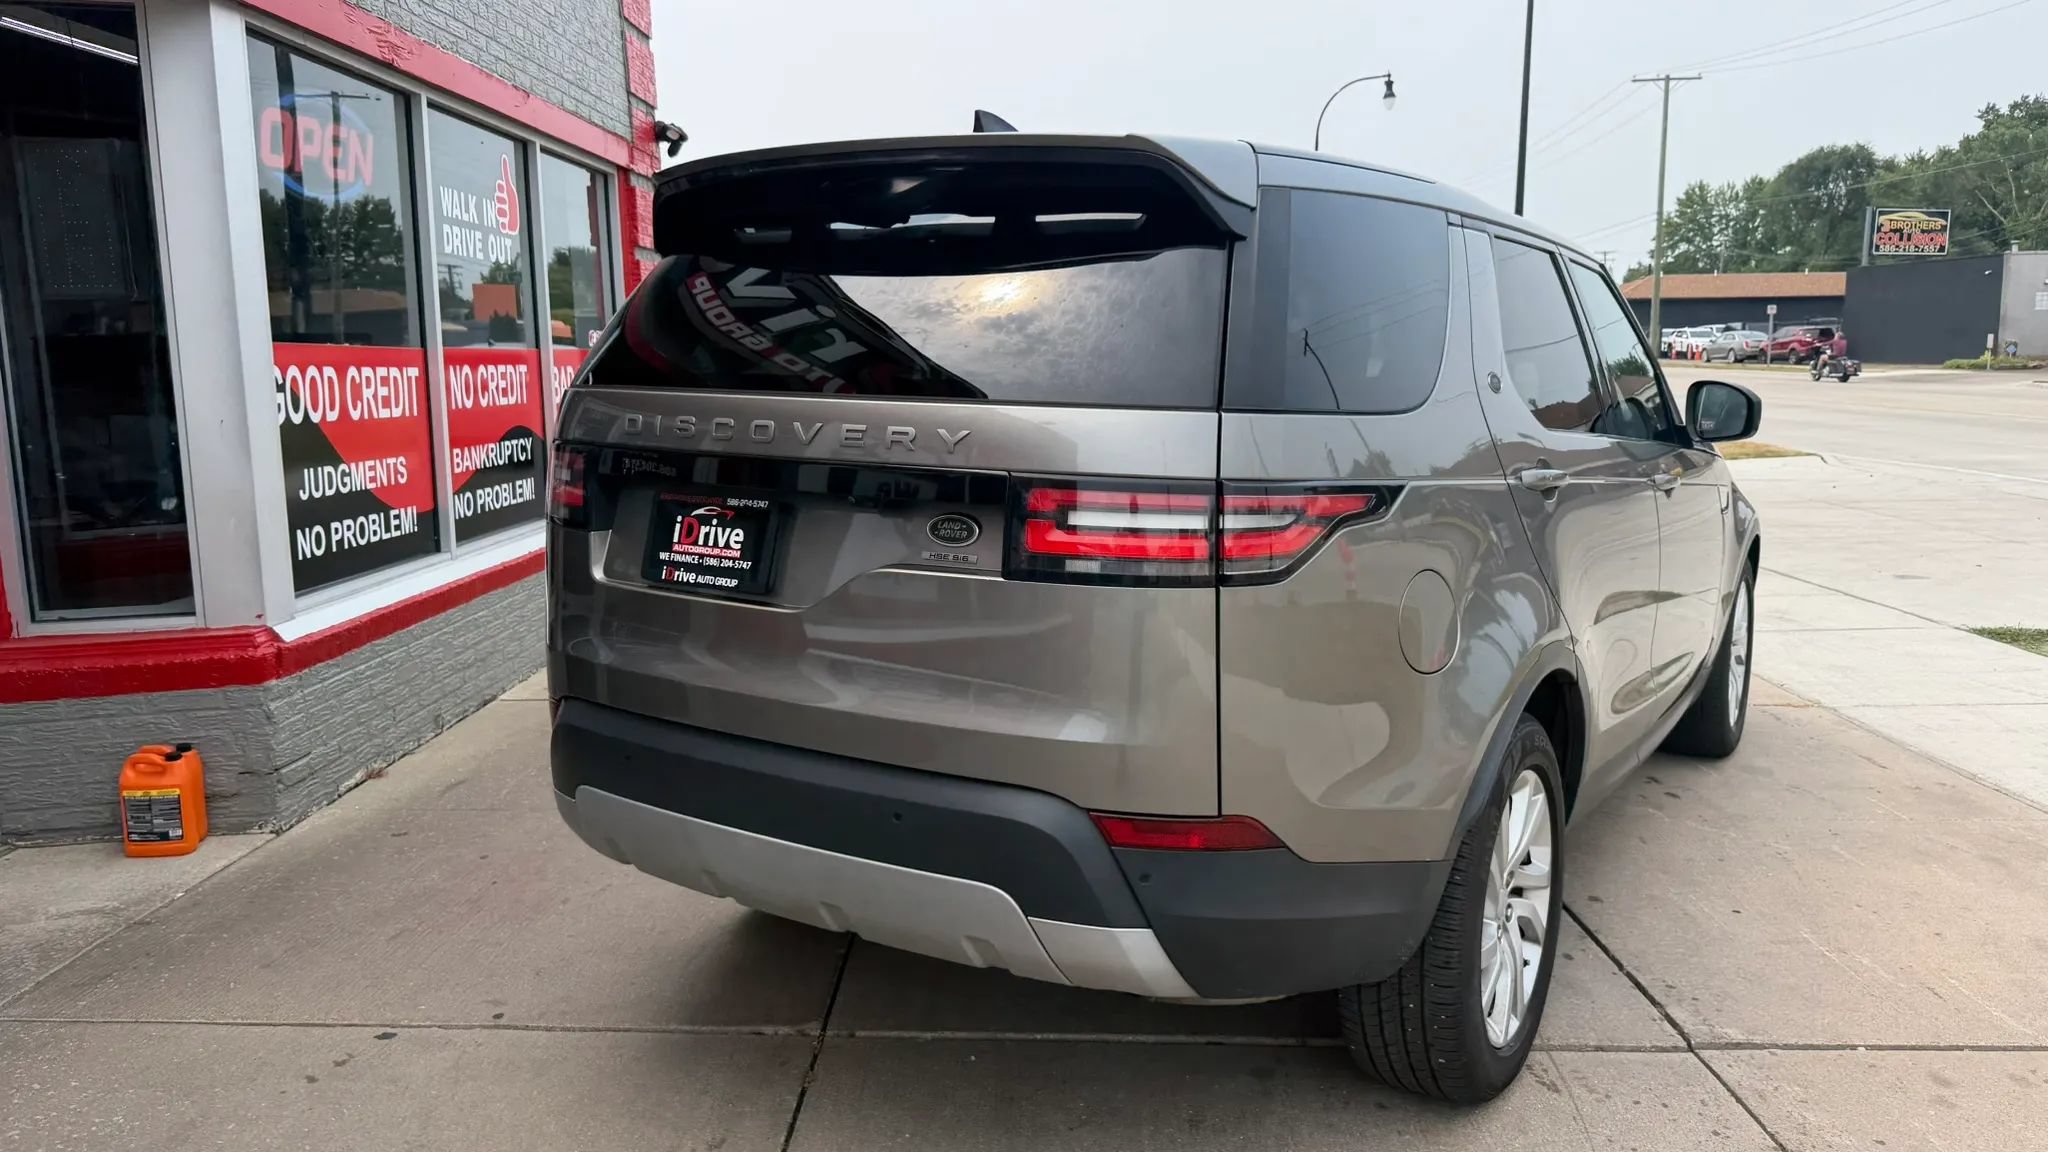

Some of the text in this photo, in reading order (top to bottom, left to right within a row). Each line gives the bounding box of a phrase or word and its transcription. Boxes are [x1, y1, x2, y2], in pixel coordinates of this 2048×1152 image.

[260, 106, 373, 186] OPEN
[440, 185, 497, 229] WALK IN
[1891, 221, 1941, 230] BROTHERS
[442, 223, 513, 265] DRIVE OUT
[1876, 232, 1947, 246] COLLISION
[1879, 245, 1940, 253] 586-218-7557
[272, 364, 420, 427] GOOD CREDIT
[449, 364, 528, 410] NO CREDIT
[624, 413, 972, 455] DISCOVERY
[453, 437, 534, 474] BANKRUPTCY
[299, 456, 407, 501] JUDGMENTS
[454, 477, 536, 520] NO PROBLEM!
[296, 505, 418, 560] NO PROBLEM!
[672, 515, 744, 550] iDrive
[672, 543, 741, 558] AUTOGROUP.COM
[659, 551, 752, 569] WE FINANCE (586) 204-5747
[929, 552, 950, 561] HSE
[661, 565, 738, 588] iDrive AUTO GROUP
